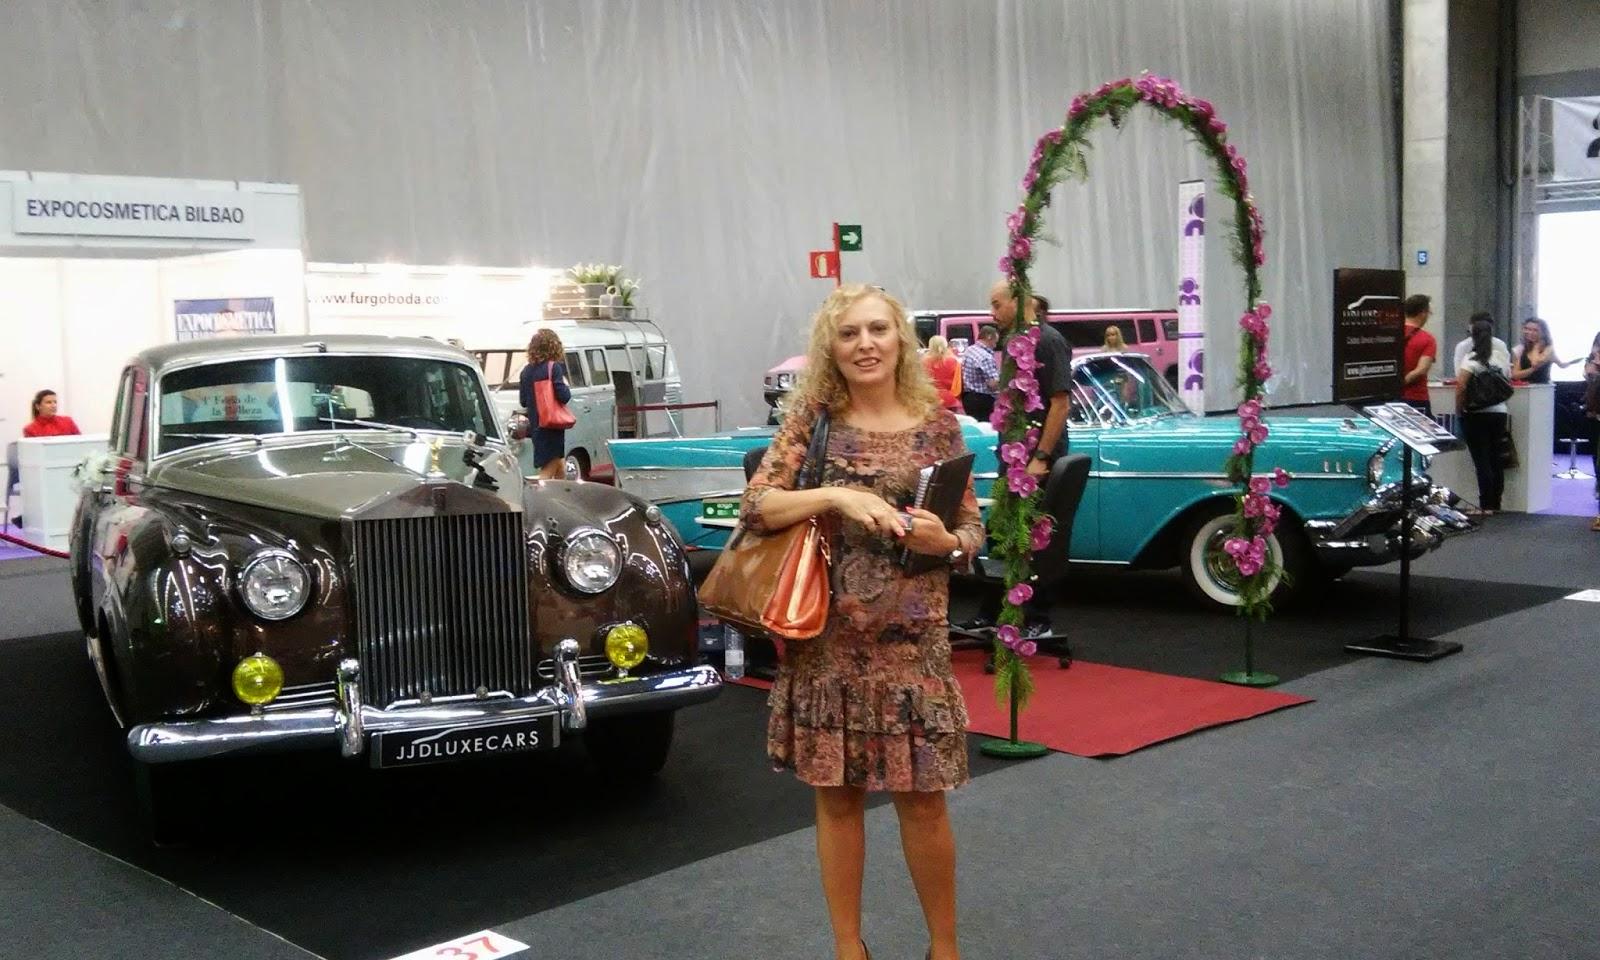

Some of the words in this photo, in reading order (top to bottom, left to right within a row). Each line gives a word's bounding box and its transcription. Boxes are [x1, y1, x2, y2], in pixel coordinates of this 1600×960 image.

[26, 199, 180, 222] EXPOCOSMETICA
[185, 205, 244, 225] BILBAO
[1418, 252, 1426, 263] 5
[396, 730, 539, 760] JJDLUXECARS
